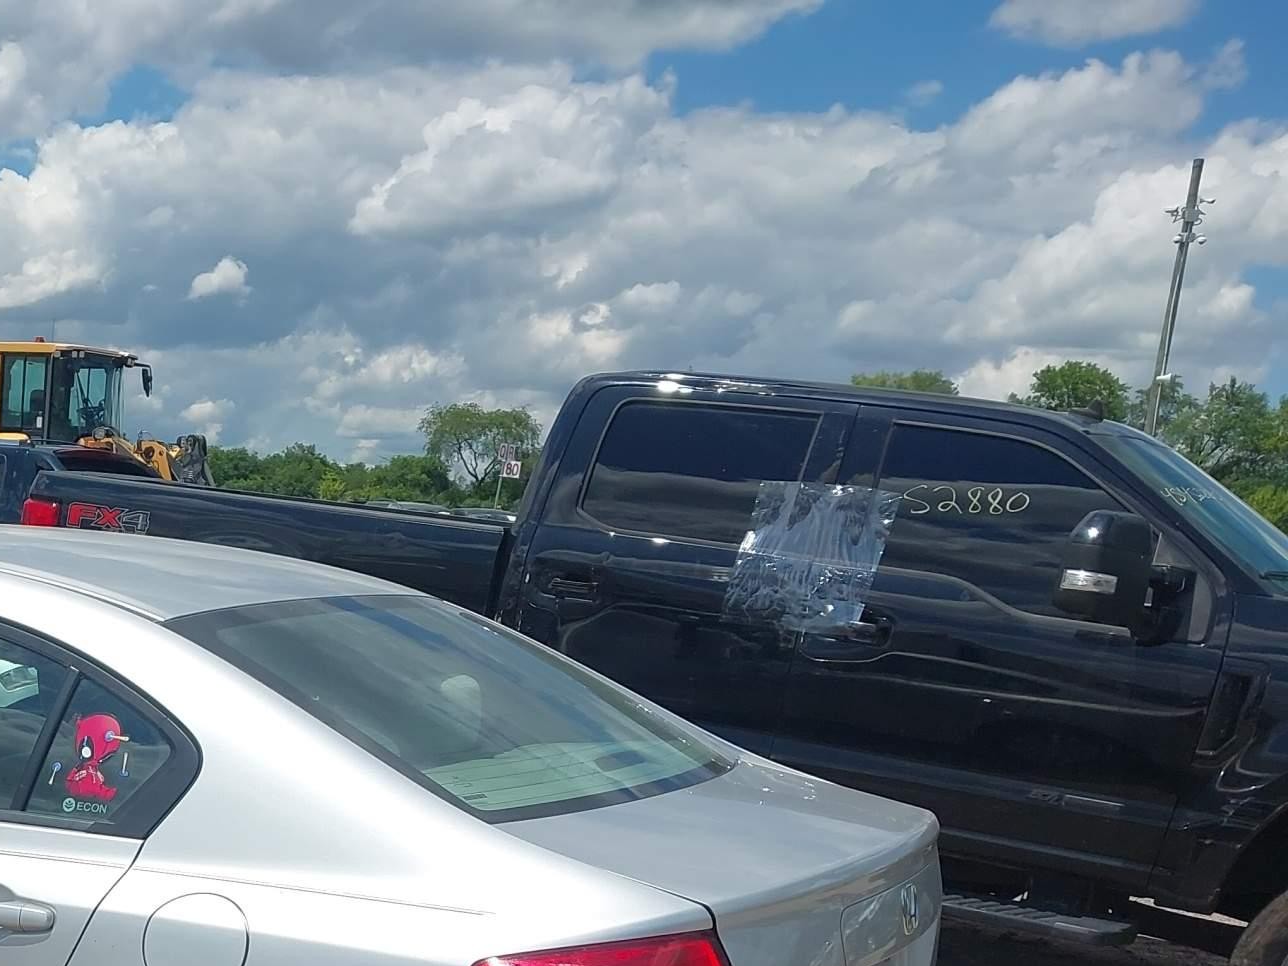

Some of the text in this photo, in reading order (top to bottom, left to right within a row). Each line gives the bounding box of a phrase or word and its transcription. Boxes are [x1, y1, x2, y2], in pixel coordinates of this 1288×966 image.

[505, 462, 520, 476] 80
[66, 502, 151, 535] FX4
[76, 801, 108, 814] ECON
